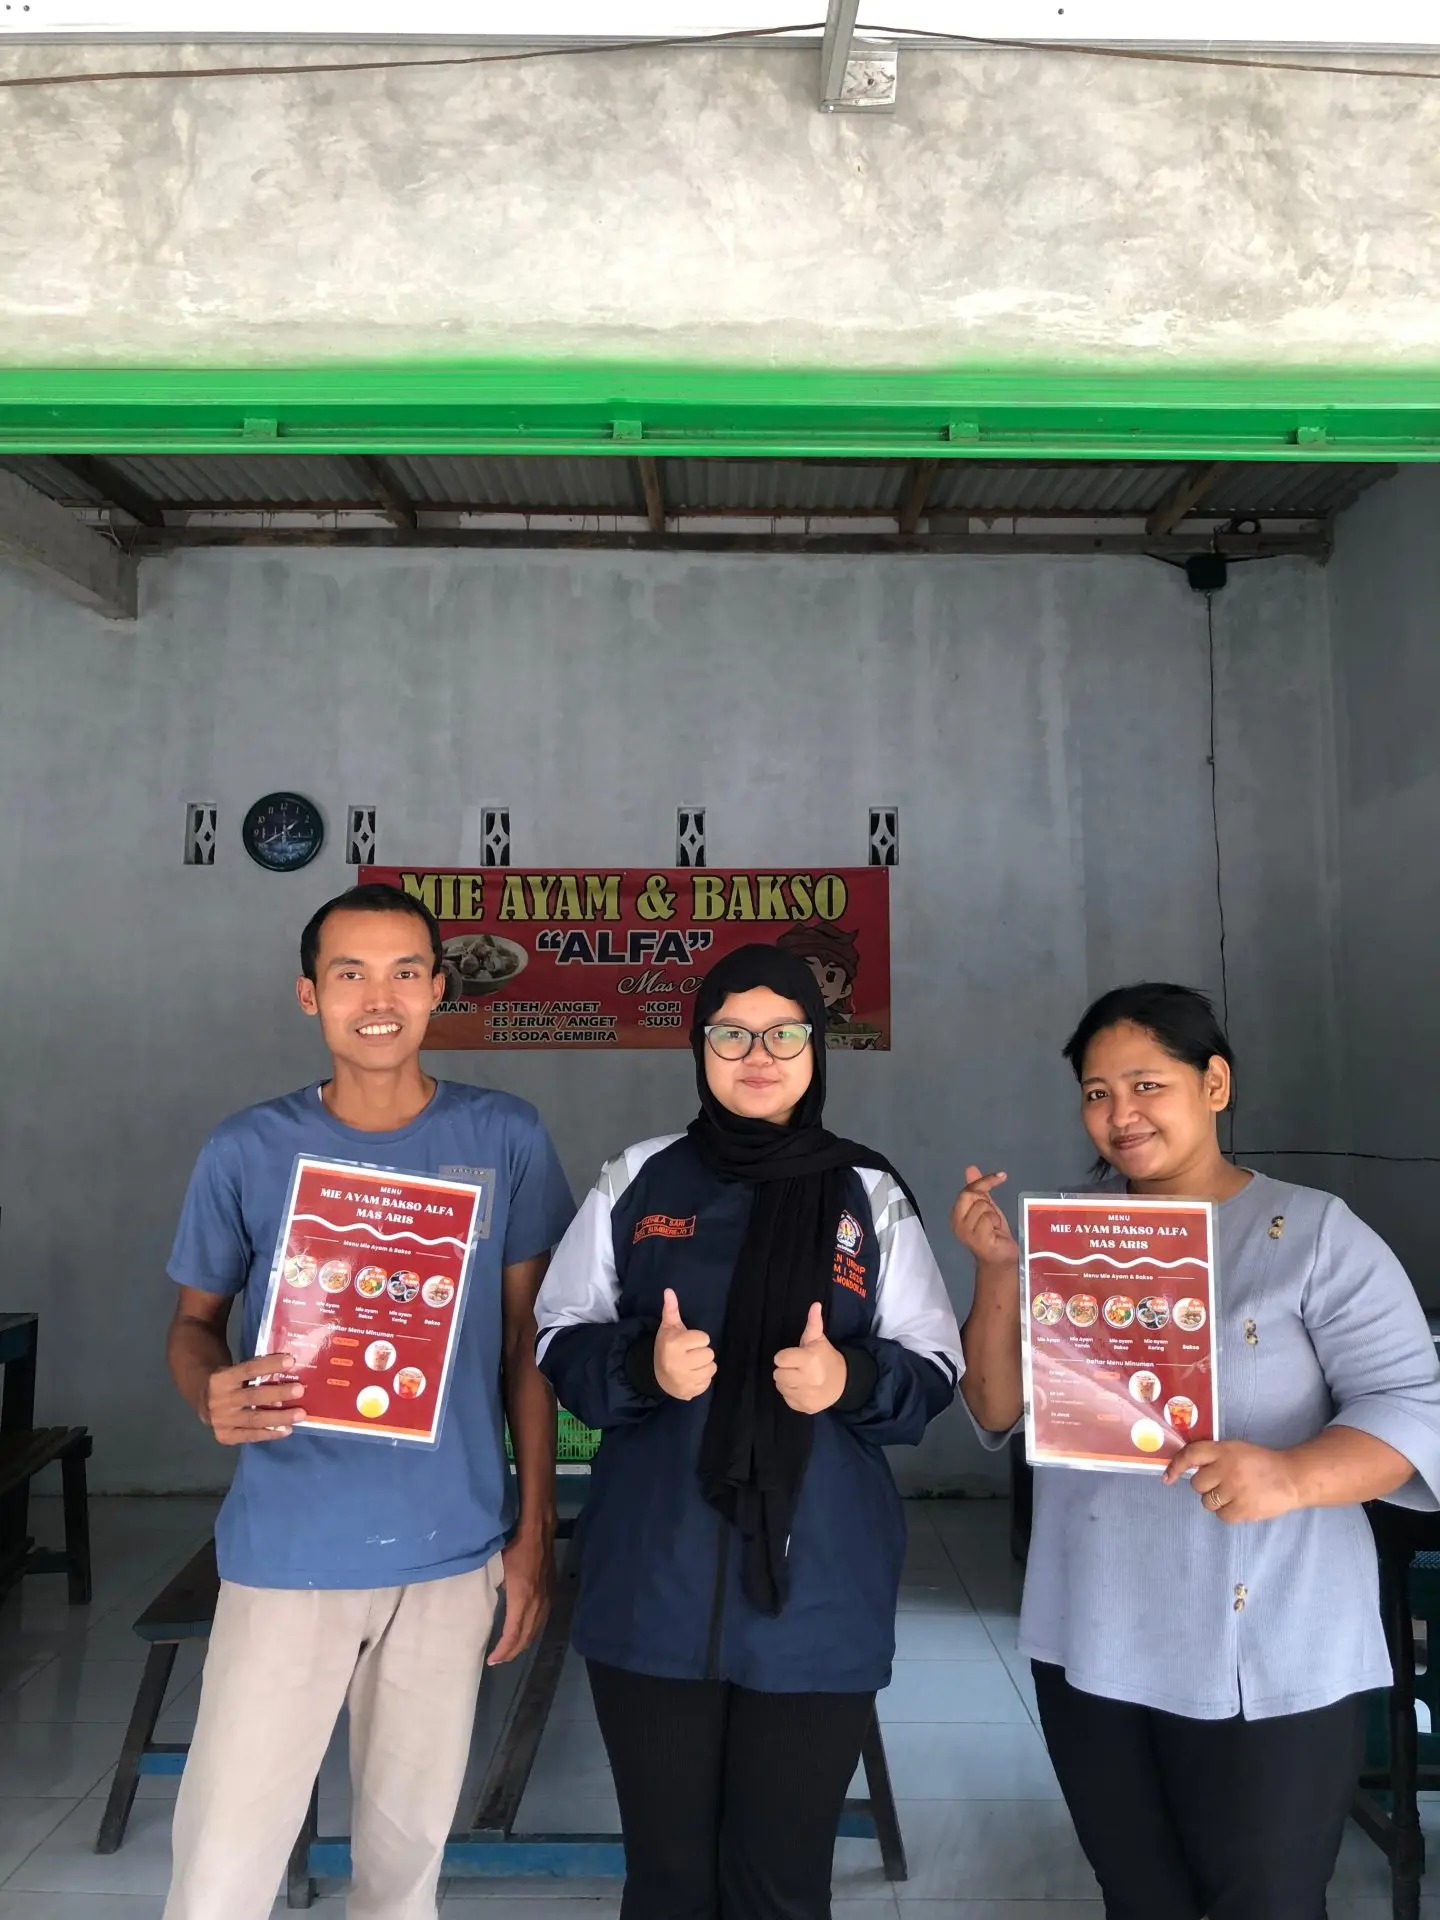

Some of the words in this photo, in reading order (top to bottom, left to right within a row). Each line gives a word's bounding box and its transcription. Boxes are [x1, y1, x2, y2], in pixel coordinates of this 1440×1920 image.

[401, 873, 484, 921] MIE
[498, 874, 622, 921] AYAM
[636, 874, 677, 921] &
[690, 874, 848, 921] BAKSO
[617, 970, 676, 994] Mas
[512, 1002, 540, 1013] TEH
[550, 1001, 601, 1013] ANGET
[510, 1016, 556, 1028] JERUK
[567, 1016, 617, 1028] ANGET
[511, 1031, 551, 1042] SODA
[553, 1030, 617, 1042] GEMBIRA
[380, 1186, 402, 1195] MENU
[320, 1188, 342, 1199] MIE
[344, 1191, 379, 1205] AYAM
[381, 1197, 422, 1211] BAKSO
[424, 1204, 454, 1216] ALFA
[356, 1208, 382, 1219] MAS
[384, 1212, 414, 1224] ARIS
[1050, 1224, 1071, 1233] MIE
[1075, 1225, 1110, 1234] AYAM
[1112, 1226, 1153, 1235] BAKSO
[1157, 1227, 1188, 1236] ALFA
[343, 1240, 360, 1248] Menu
[371, 1244, 388, 1252] Ayam
[1089, 1239, 1115, 1248] MAS
[1119, 1240, 1148, 1249] ARIS
[348, 1326, 365, 1335] Menu
[365, 1328, 394, 1338] Minuman
